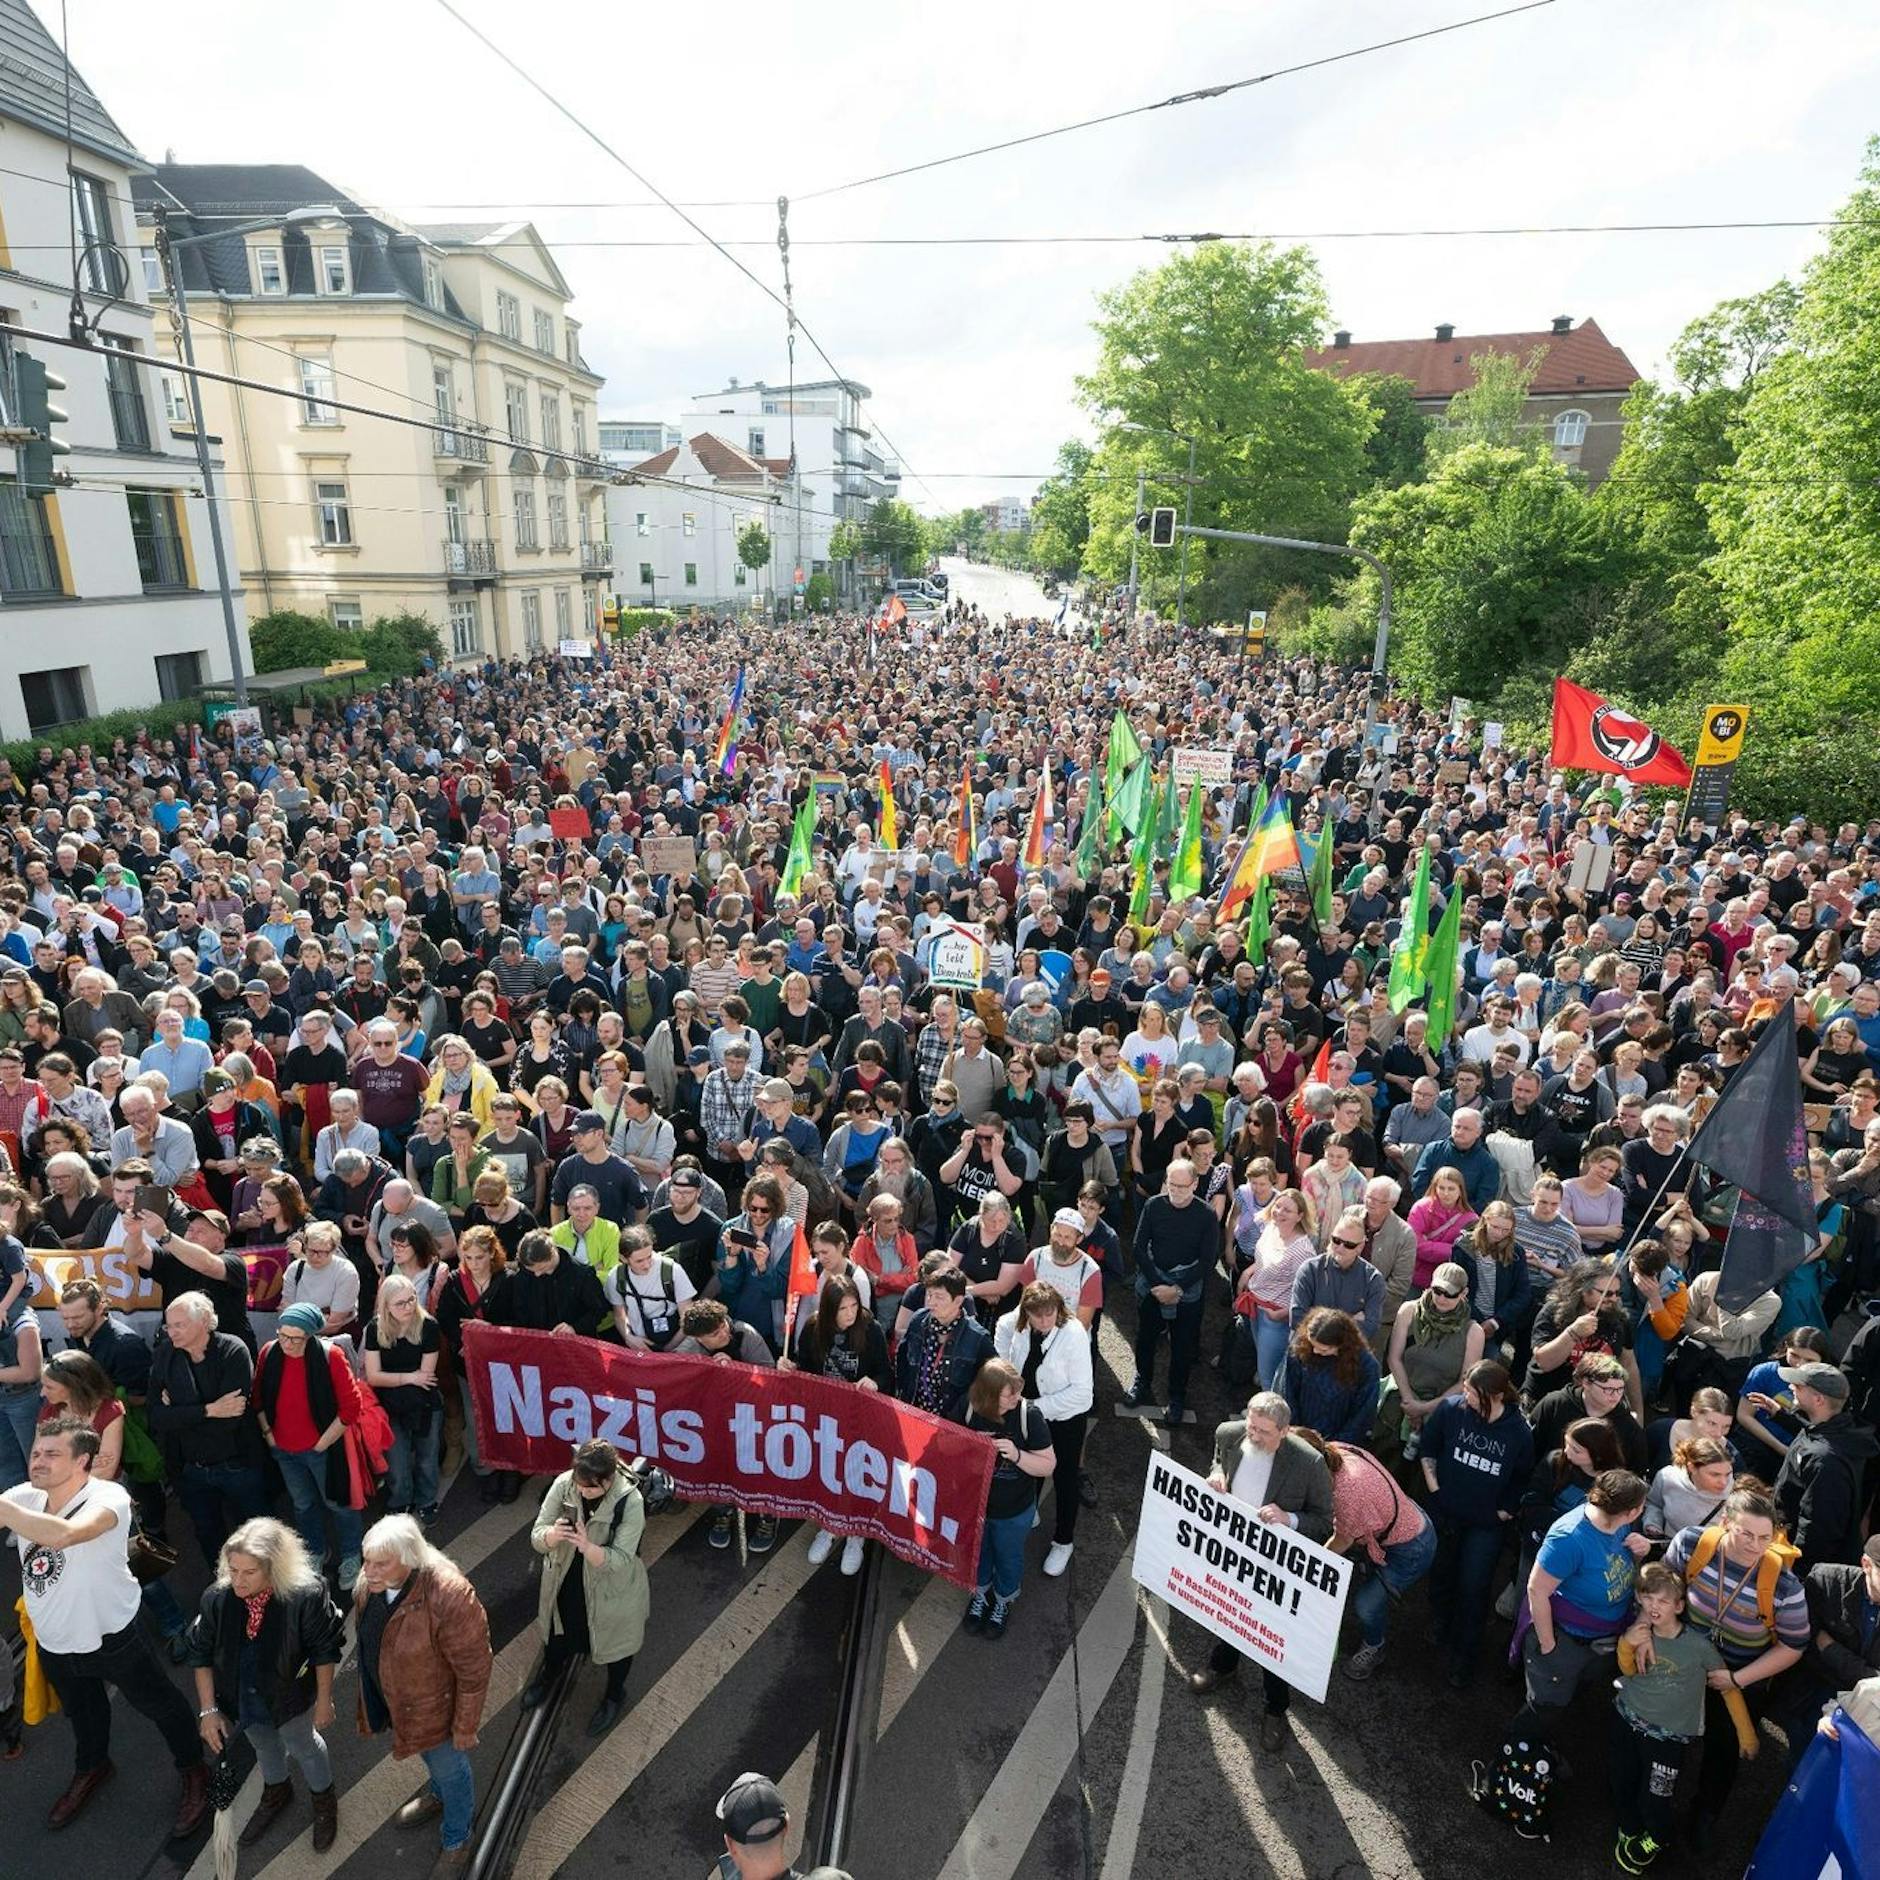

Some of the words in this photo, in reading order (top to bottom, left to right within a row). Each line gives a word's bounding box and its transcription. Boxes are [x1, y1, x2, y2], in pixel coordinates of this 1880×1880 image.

[957, 1178, 988, 1201] LIEB
[488, 1361, 706, 1465] Nazis
[729, 1401, 960, 1546] töten.
[1453, 1446, 1502, 1476] LIEBE
[1458, 1428, 1506, 1457] MOIN
[1152, 1465, 1340, 1598] HASSPREDIGER
[1176, 1518, 1286, 1607] STOPPEN
[1170, 1566, 1184, 1582] für
[1185, 1575, 1238, 1617] Rassismus
[1239, 1605, 1258, 1629] und
[1259, 1623, 1285, 1649] Hass
[1205, 1573, 1227, 1595] Kein
[1228, 1587, 1253, 1612] Platz
[1177, 1584, 1215, 1618] unserer
[1216, 1611, 1278, 1661] Gesellschaft
[1508, 1777, 1536, 1805] Volt
